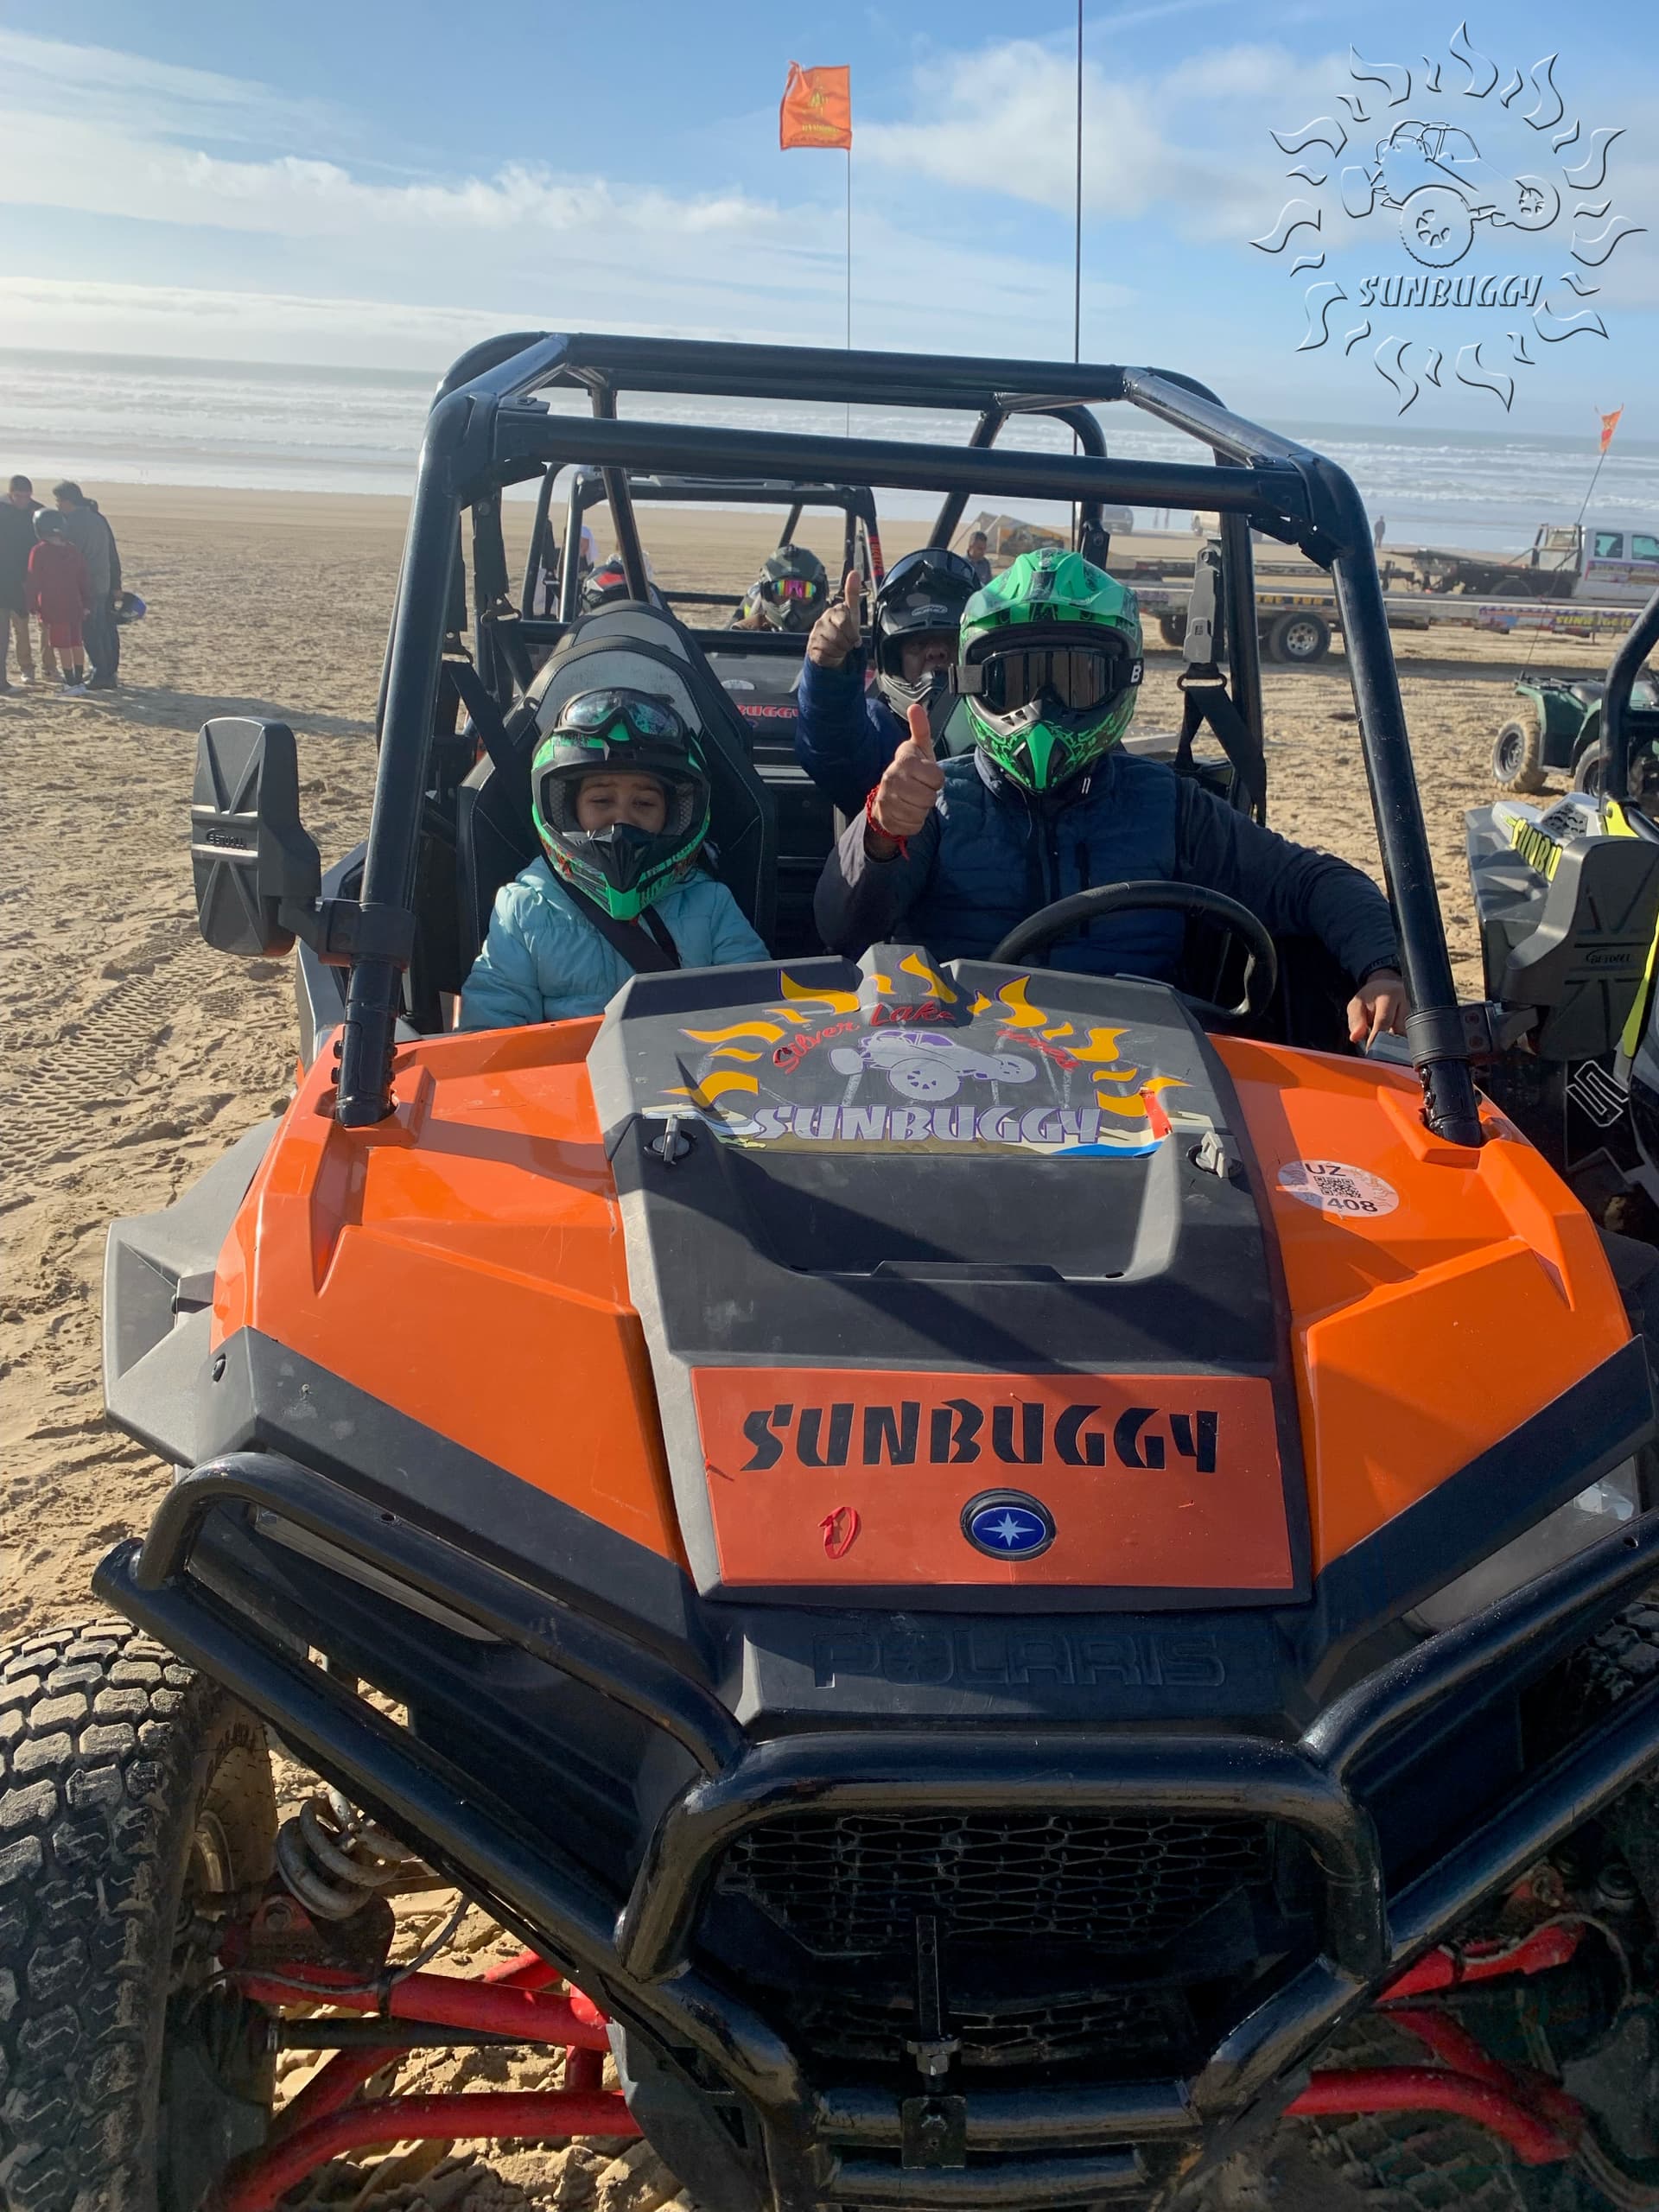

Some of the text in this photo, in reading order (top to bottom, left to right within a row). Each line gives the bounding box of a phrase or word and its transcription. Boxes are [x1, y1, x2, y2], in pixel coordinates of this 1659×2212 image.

[772, 1020, 861, 1075] Silver
[753, 1103, 1103, 1145] SUNBUGGY
[1305, 1162, 1346, 1177] UZ
[1327, 1198, 1378, 1212] 408
[740, 1398, 1219, 1473] SUNBUGGY
[812, 1629, 1226, 1689] POLARIS
